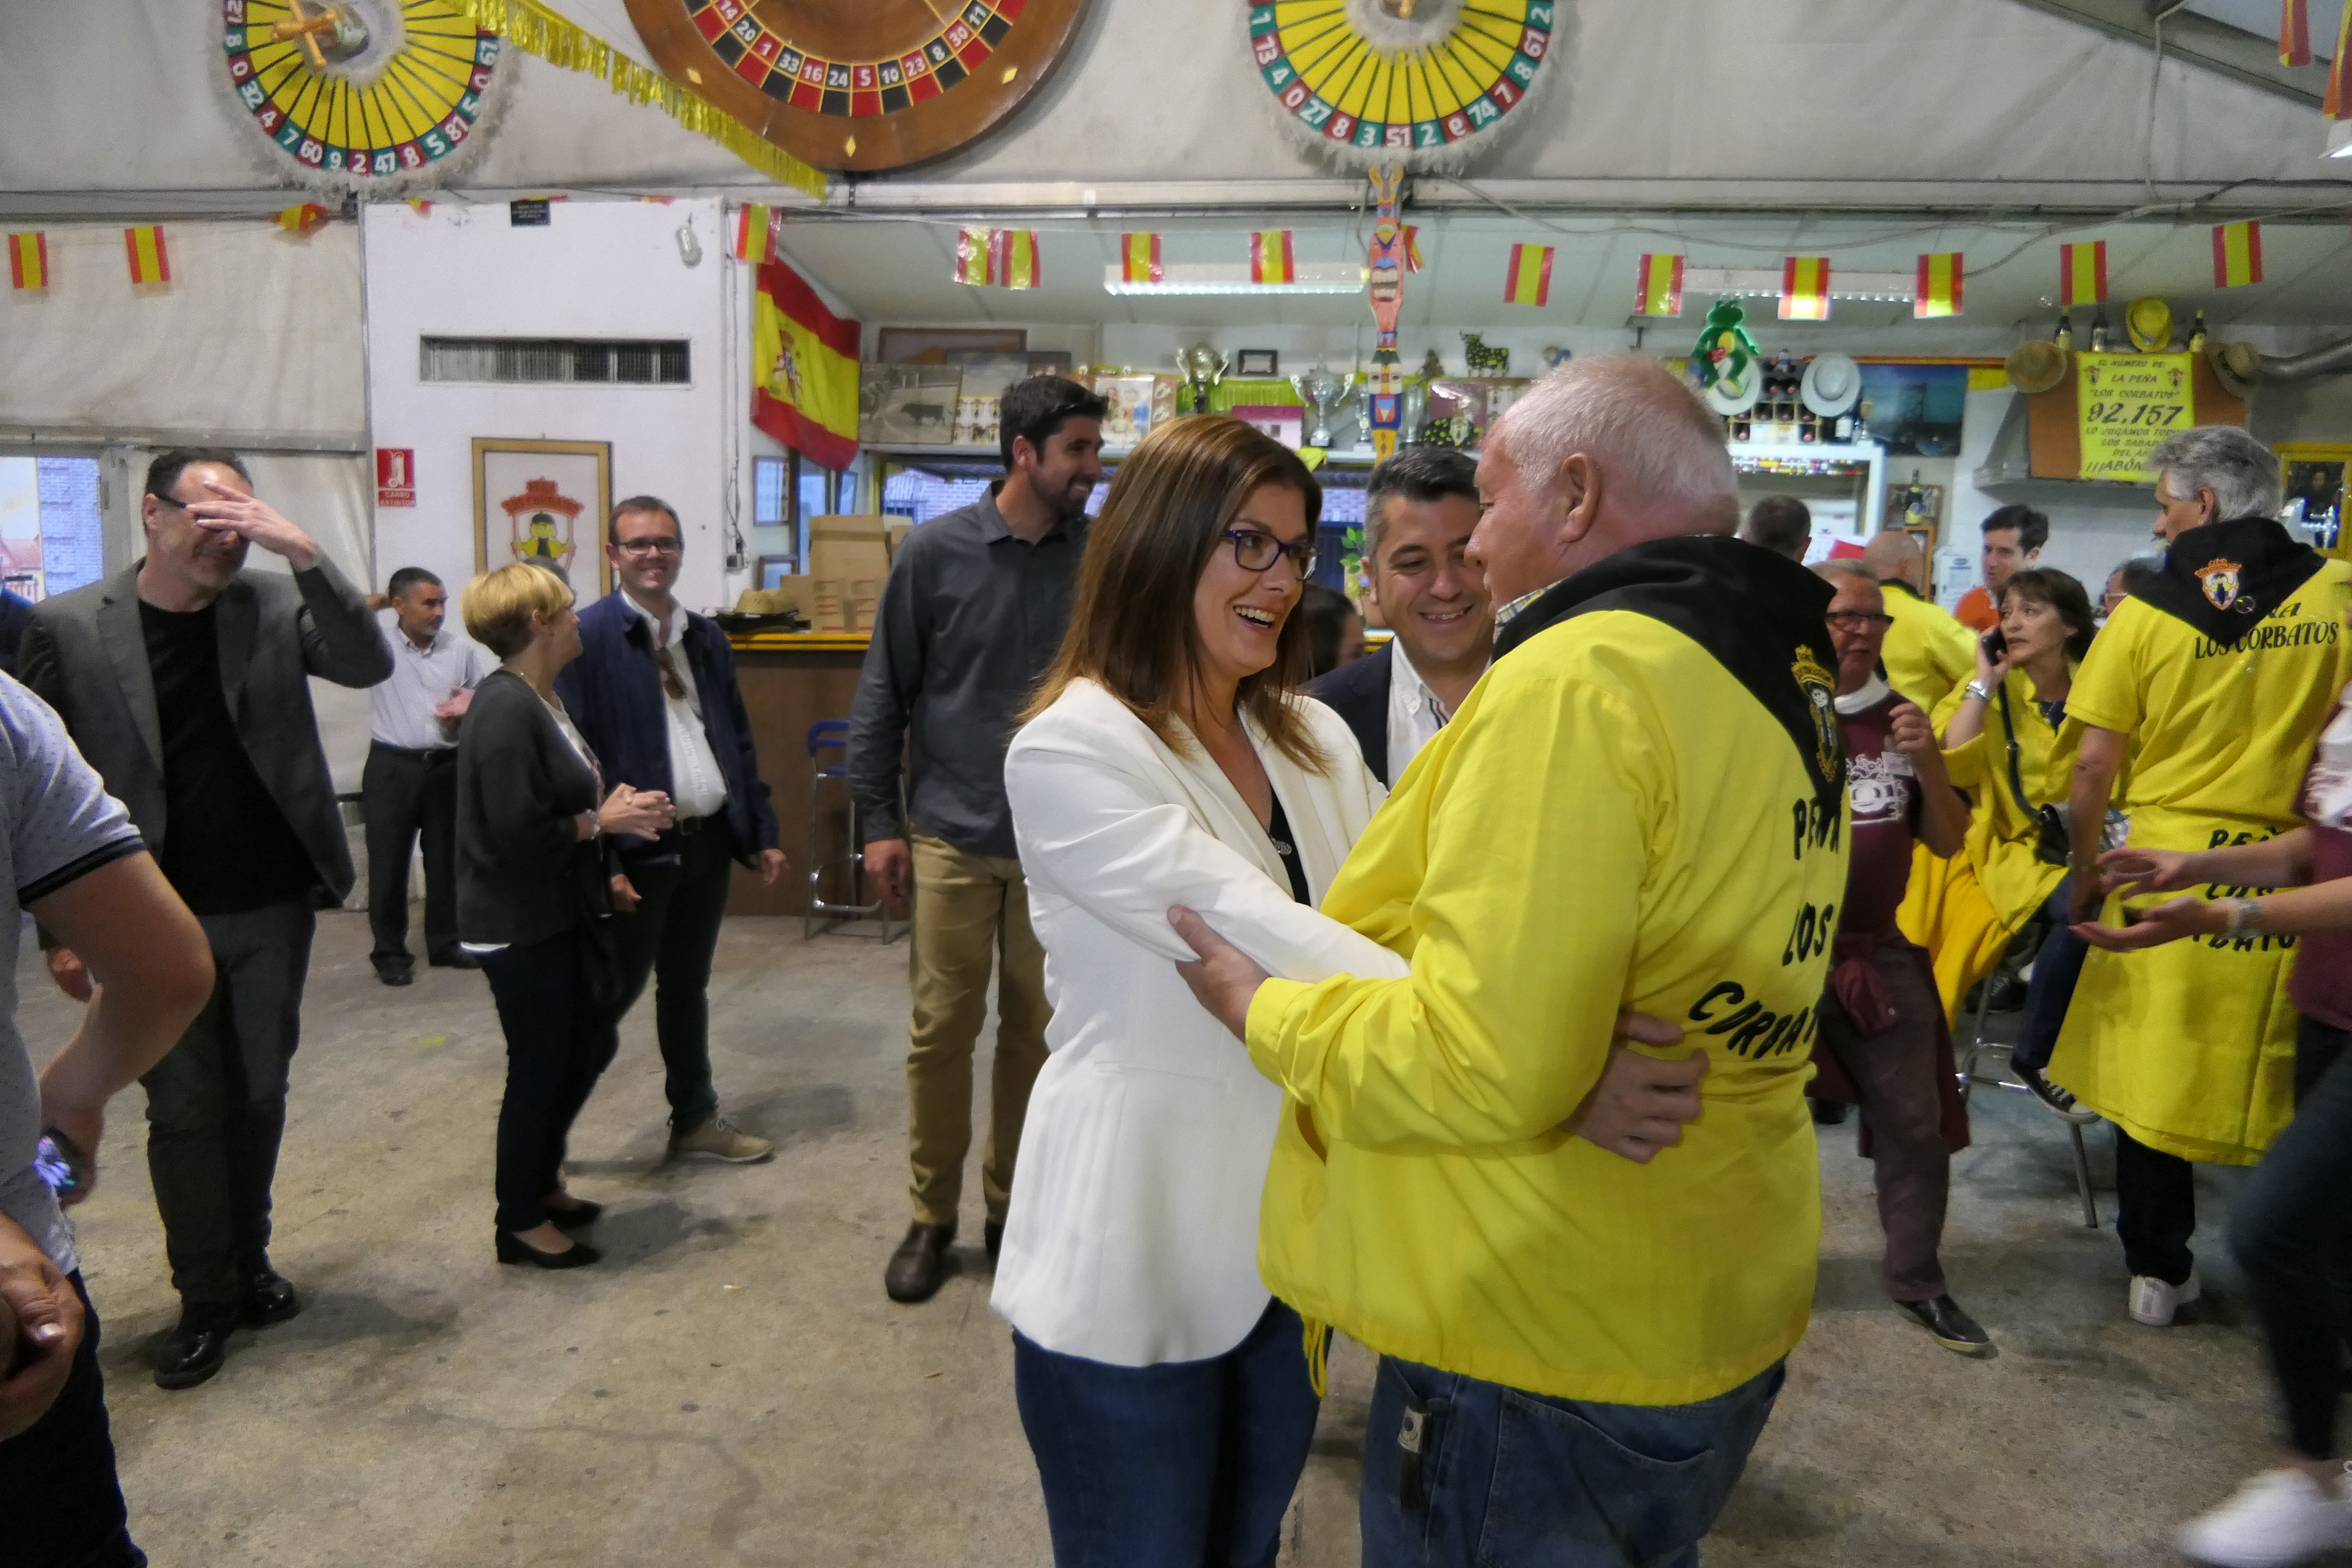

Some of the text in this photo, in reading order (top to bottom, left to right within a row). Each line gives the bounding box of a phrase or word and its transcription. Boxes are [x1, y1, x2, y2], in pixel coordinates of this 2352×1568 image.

[969, 5, 987, 26] 11
[736, 21, 756, 41] 20
[949, 26, 969, 47] 30
[761, 42, 773, 57] 1
[931, 44, 945, 62] 8
[232, 60, 248, 77] 0
[778, 53, 801, 73] 33
[905, 57, 926, 77] 23
[1514, 62, 1533, 80] 8
[803, 66, 822, 83] 16
[828, 71, 848, 87] 24
[860, 69, 872, 87] 5
[882, 69, 900, 85] 10
[1271, 67, 1290, 85] 4
[1286, 88, 1305, 107] 0
[1494, 84, 1512, 104] 7
[260, 110, 277, 128] 4
[1298, 99, 1332, 124] 27
[1467, 100, 1496, 125] 74
[285, 128, 300, 146] 7
[1332, 118, 1351, 138] 8
[1361, 126, 1376, 146] 3
[1386, 127, 1412, 147] 51
[1420, 125, 1436, 146] 2
[299, 140, 322, 164] 60
[426, 135, 446, 155] 5
[329, 151, 342, 170] 9
[351, 154, 367, 172] 2
[403, 147, 419, 167] 8
[2129, 374, 2157, 383] PEÑA
[2087, 403, 2184, 426] 92.157
[1782, 902, 1834, 967] LOS
